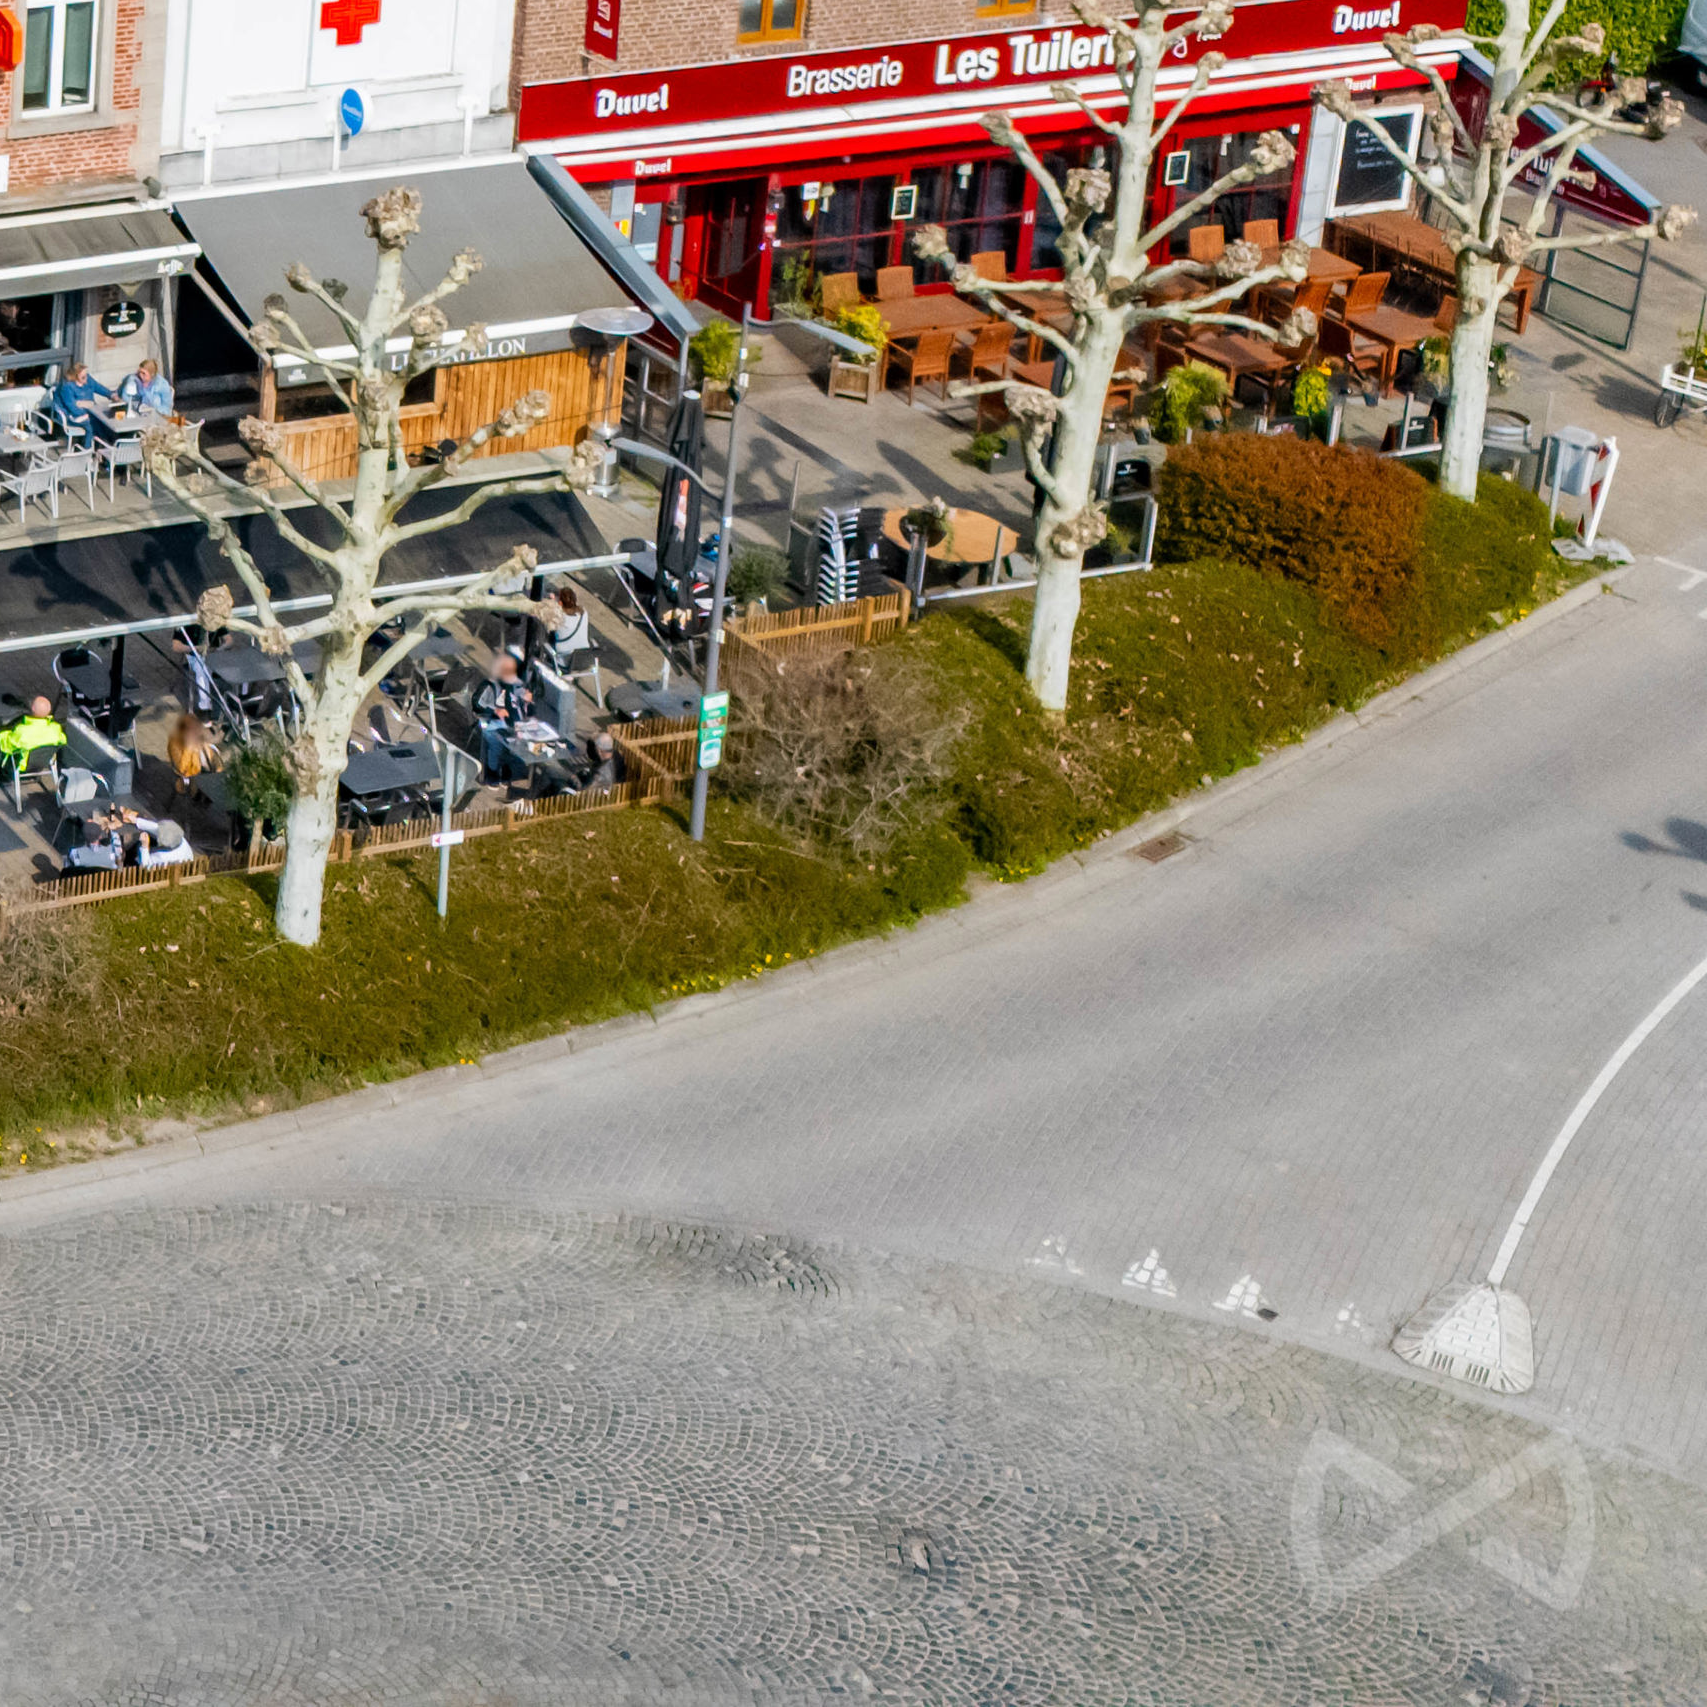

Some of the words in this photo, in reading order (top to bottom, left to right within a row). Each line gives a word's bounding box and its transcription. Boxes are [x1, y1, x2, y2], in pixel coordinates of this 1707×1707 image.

[1333, 0, 1401, 34] Duvel
[787, 56, 904, 98] Brasserie
[935, 43, 1000, 86] Les
[1009, 29, 1136, 76] Tuileri
[596, 83, 669, 118] Duvel
[635, 157, 672, 177] Duvel
